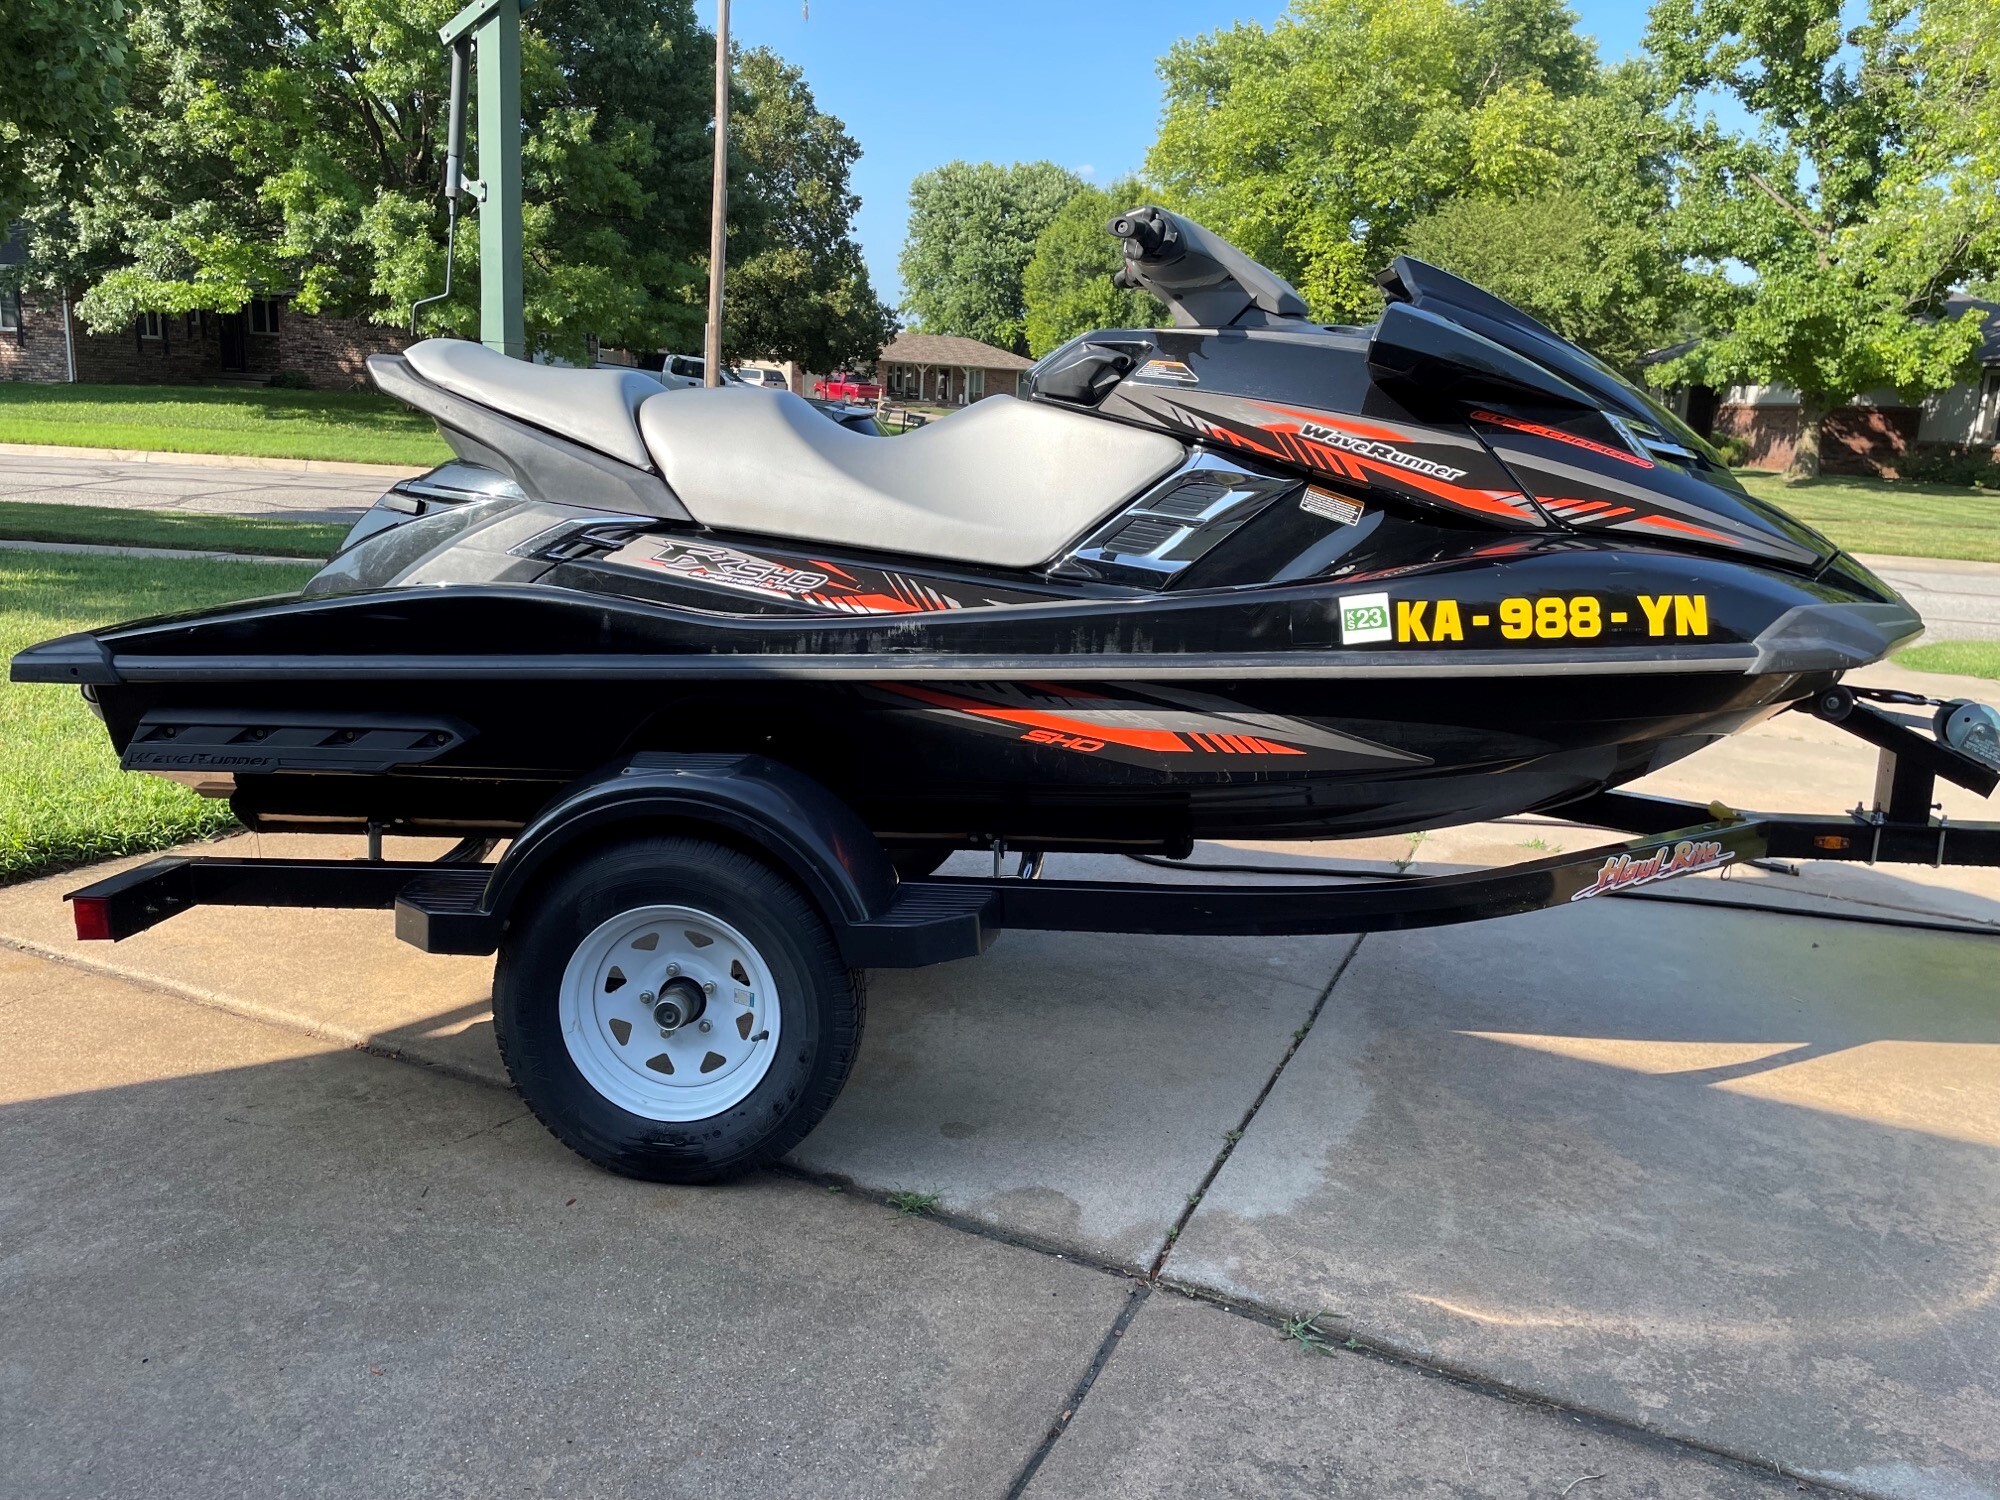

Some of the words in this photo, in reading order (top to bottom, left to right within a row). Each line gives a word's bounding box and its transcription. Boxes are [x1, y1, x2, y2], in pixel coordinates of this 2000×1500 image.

[1299, 421, 1468, 481] WaveRunner
[689, 570, 733, 582] SUPER
[733, 577, 759, 587] HIGH
[759, 582, 811, 594] OUTPUT
[1357, 608, 1382, 629] 23
[1020, 729, 1105, 752] SHO
[129, 752, 273, 766] WaveRunner
[1597, 846, 1668, 888] Haul
[1670, 841, 1721, 872] Rite
